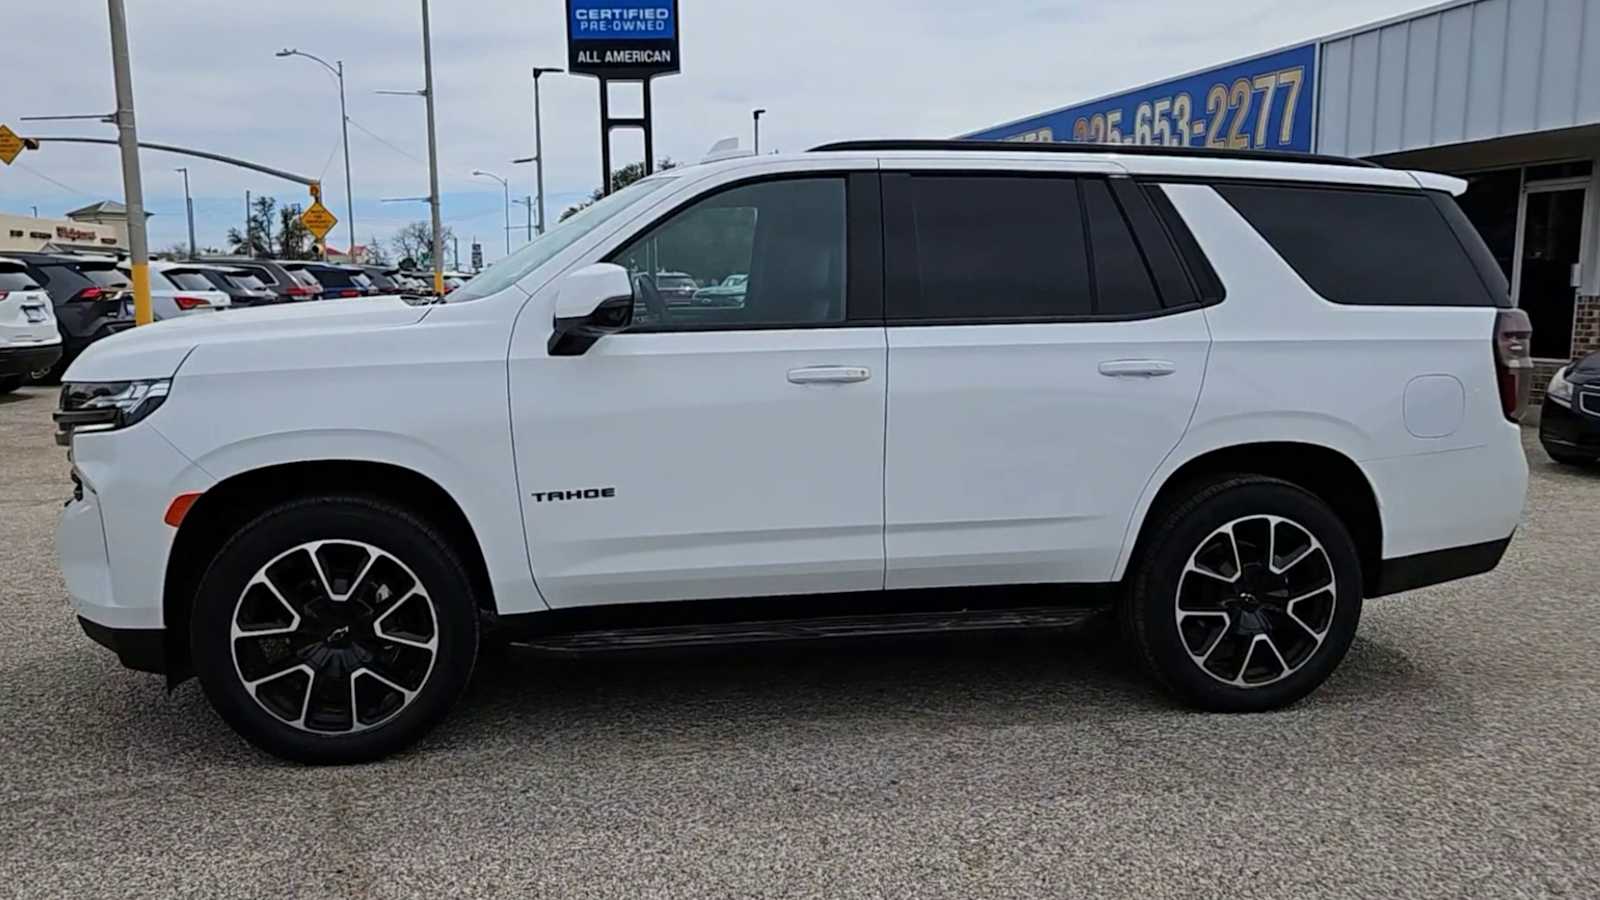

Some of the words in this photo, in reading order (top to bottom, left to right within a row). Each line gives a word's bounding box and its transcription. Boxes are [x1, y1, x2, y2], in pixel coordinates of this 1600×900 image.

[575, 8, 669, 20] CERTIFIED
[580, 20, 665, 31] PRE-OWNED
[577, 50, 601, 63] ALL
[604, 50, 671, 63] AMERICAN
[531, 487, 616, 503] TAHOE
